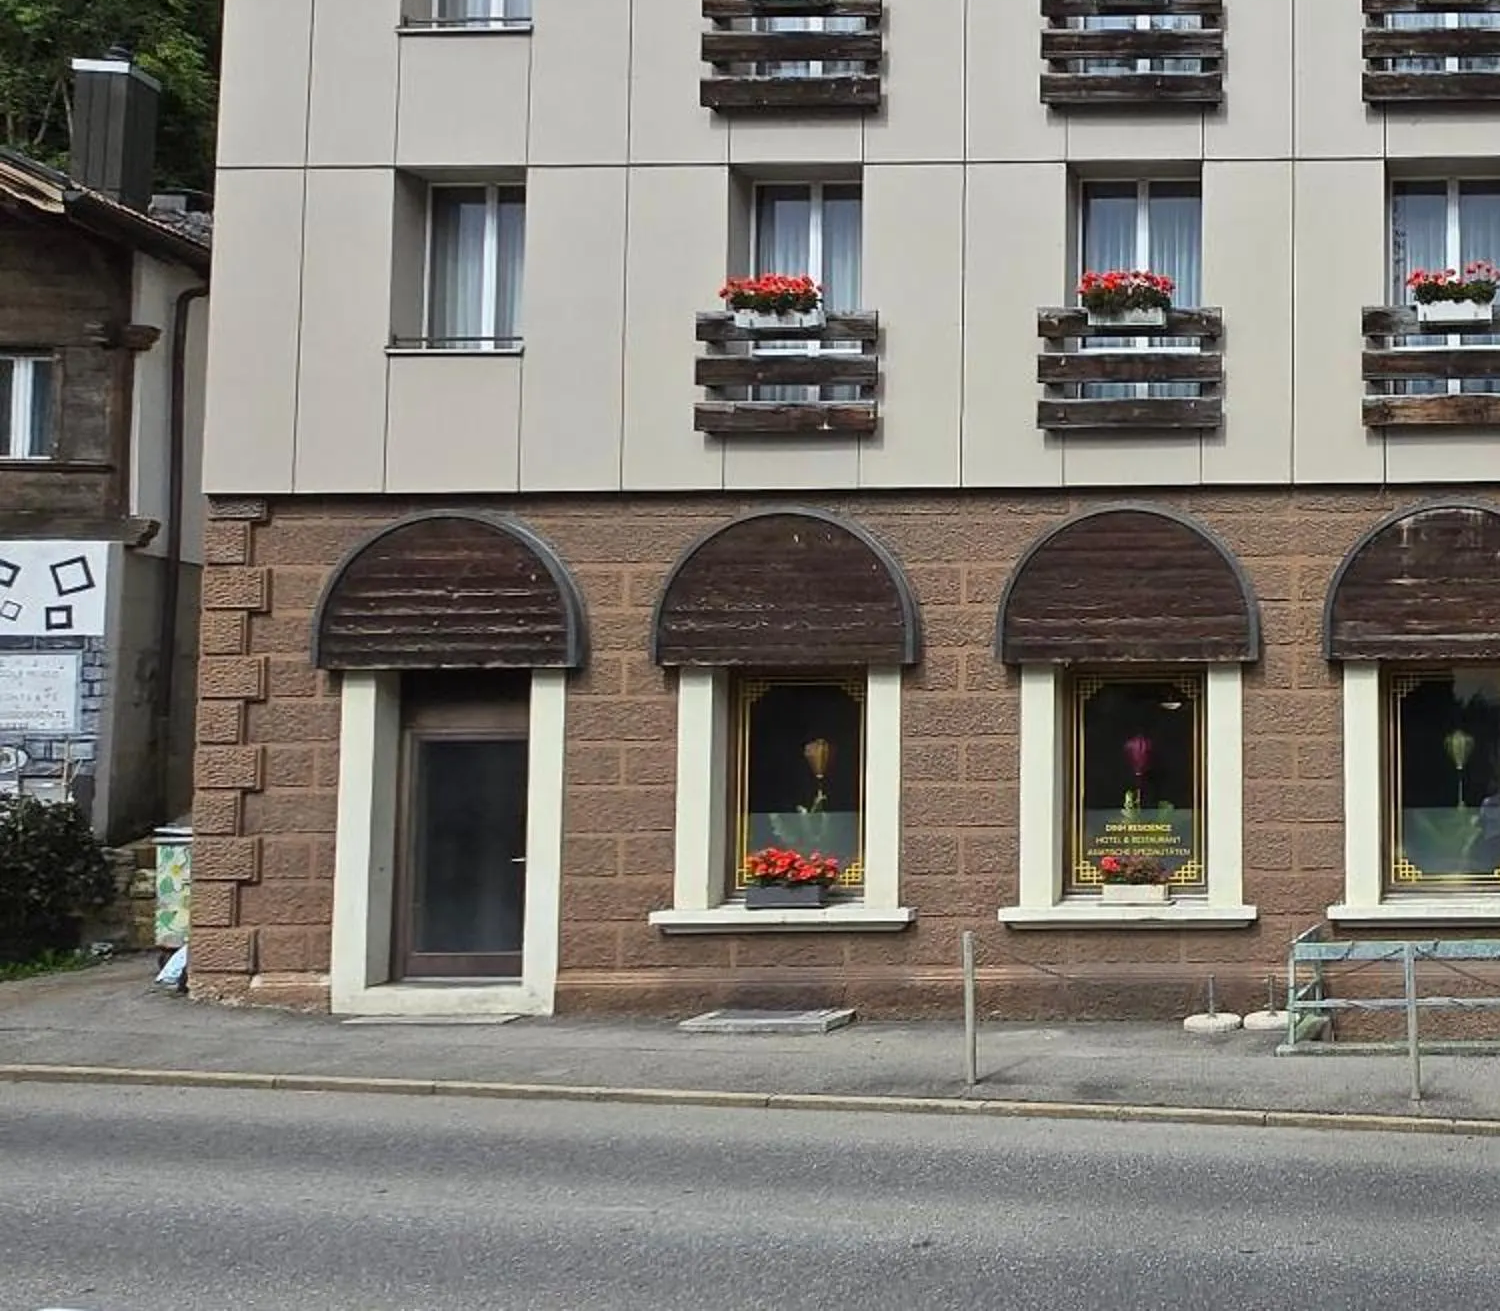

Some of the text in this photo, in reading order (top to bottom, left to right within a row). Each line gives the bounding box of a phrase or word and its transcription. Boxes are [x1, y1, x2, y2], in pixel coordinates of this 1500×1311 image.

[1105, 824, 1172, 832] DINH RESIDENCE
[1095, 836, 1121, 844] HOTEL
[1132, 836, 1181, 844] RESTAURANT
